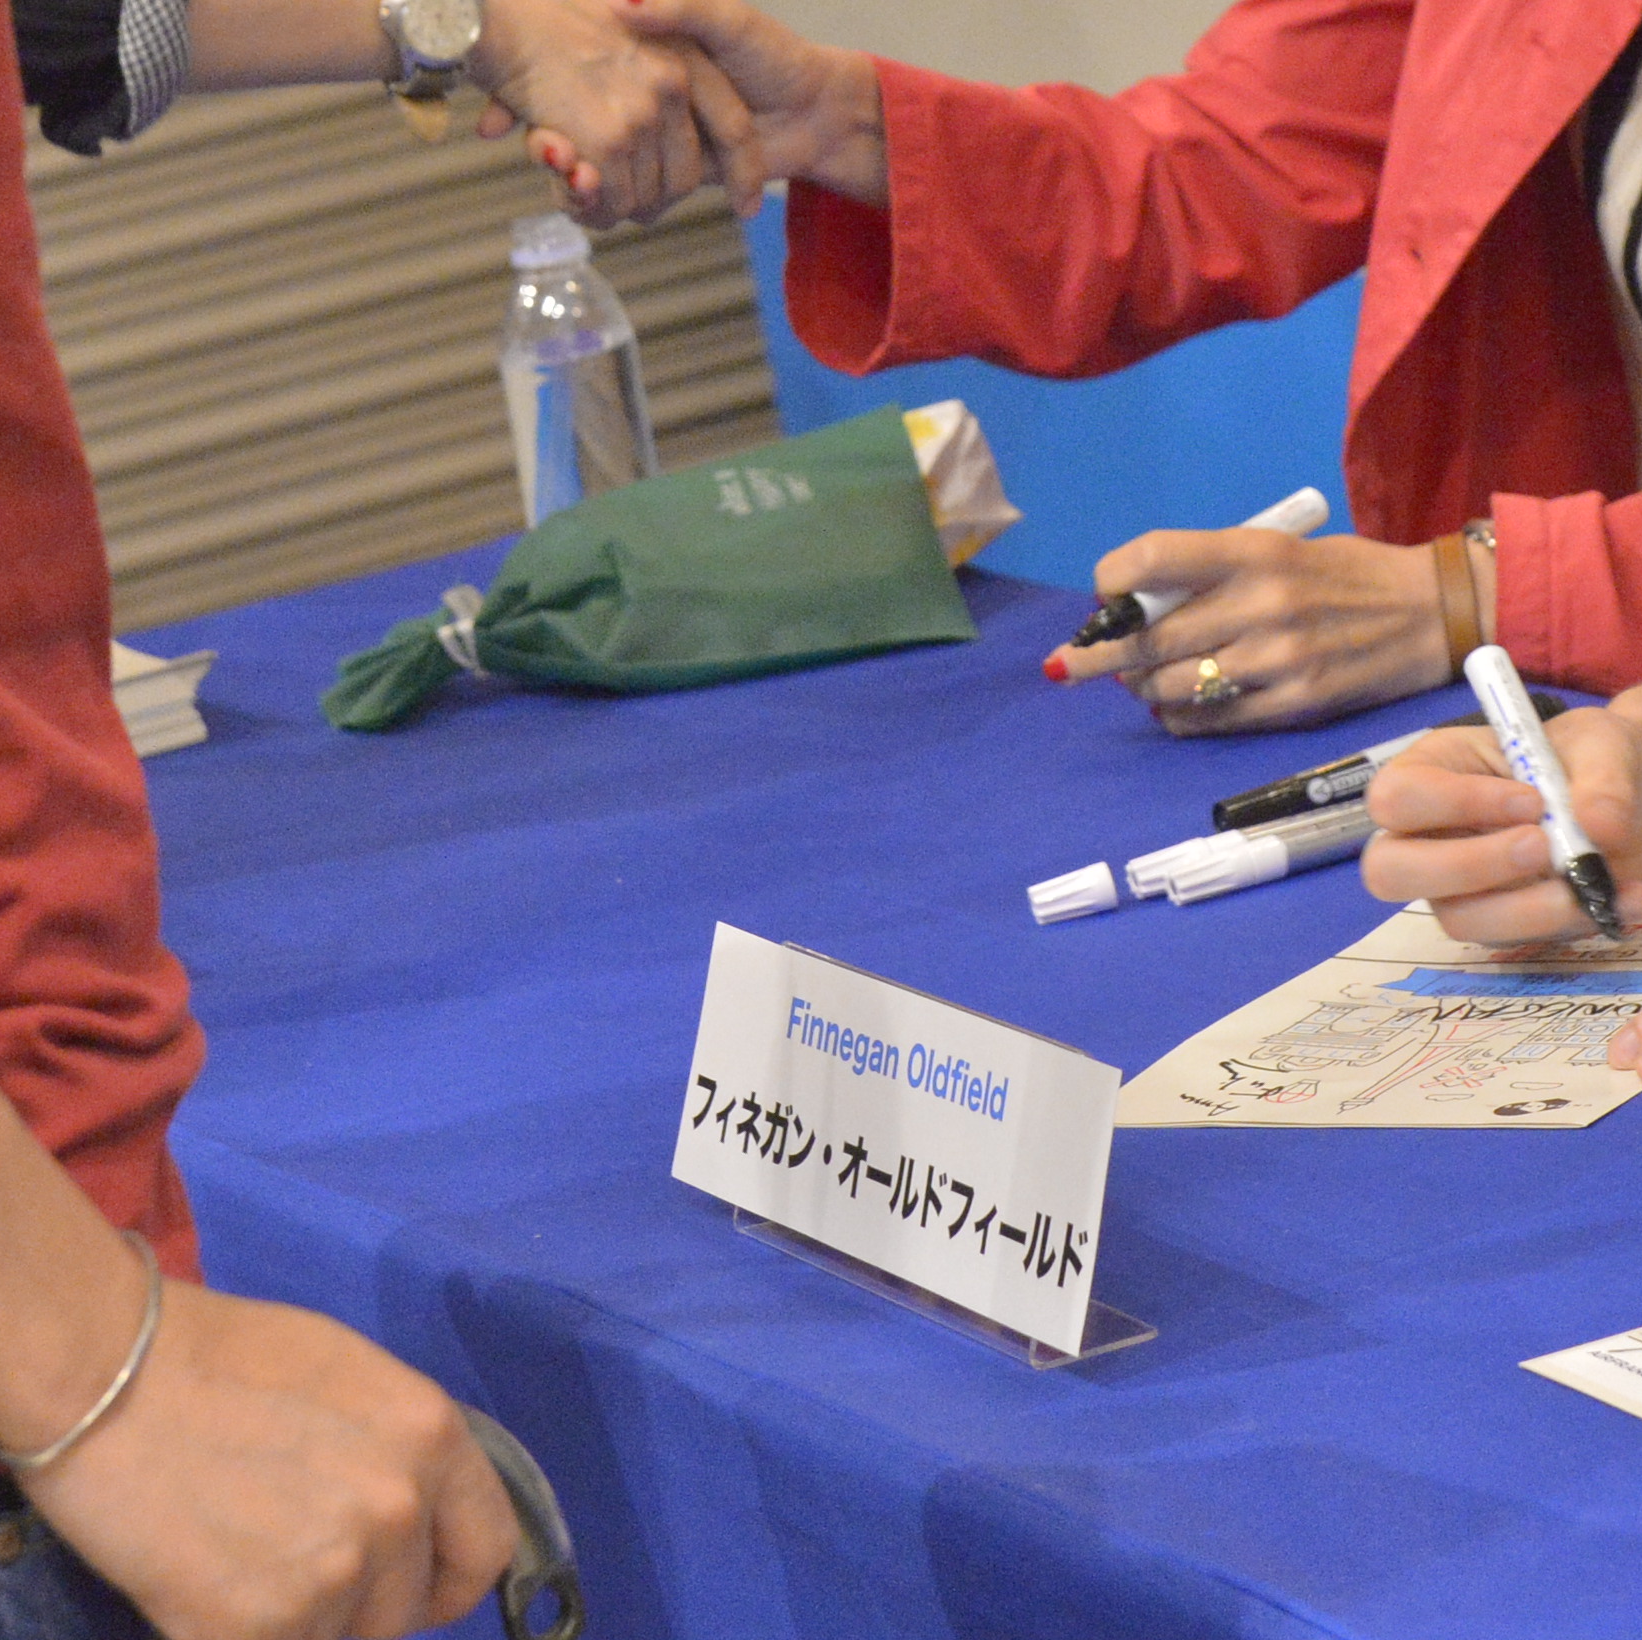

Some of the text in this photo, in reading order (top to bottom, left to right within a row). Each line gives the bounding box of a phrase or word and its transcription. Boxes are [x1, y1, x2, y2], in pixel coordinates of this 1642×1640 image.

[785, 996, 1012, 1123] Finnegan Oldfield
[690, 1073, 1089, 1289] フィネガン・オールドフィールド
